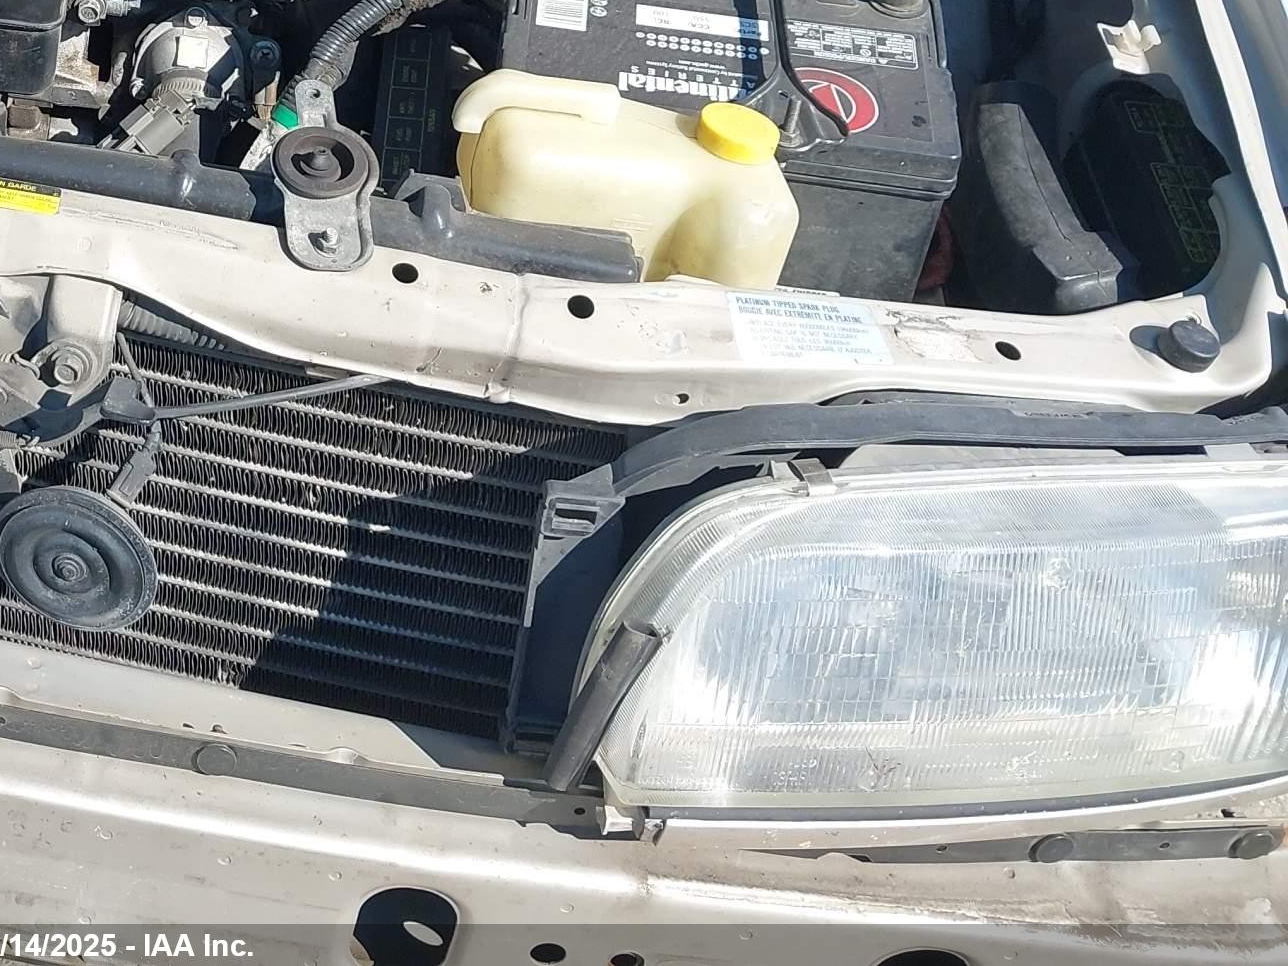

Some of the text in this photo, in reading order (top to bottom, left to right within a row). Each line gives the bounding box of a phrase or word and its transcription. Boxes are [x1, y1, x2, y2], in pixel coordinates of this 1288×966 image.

[630, 65, 755, 89] ATTERIES
[7, 182, 37, 192] GARDE
[736, 296, 840, 313] PLATINUM TIPPED SPARK PLUG
[784, 310, 822, 321] EXTREMITE
